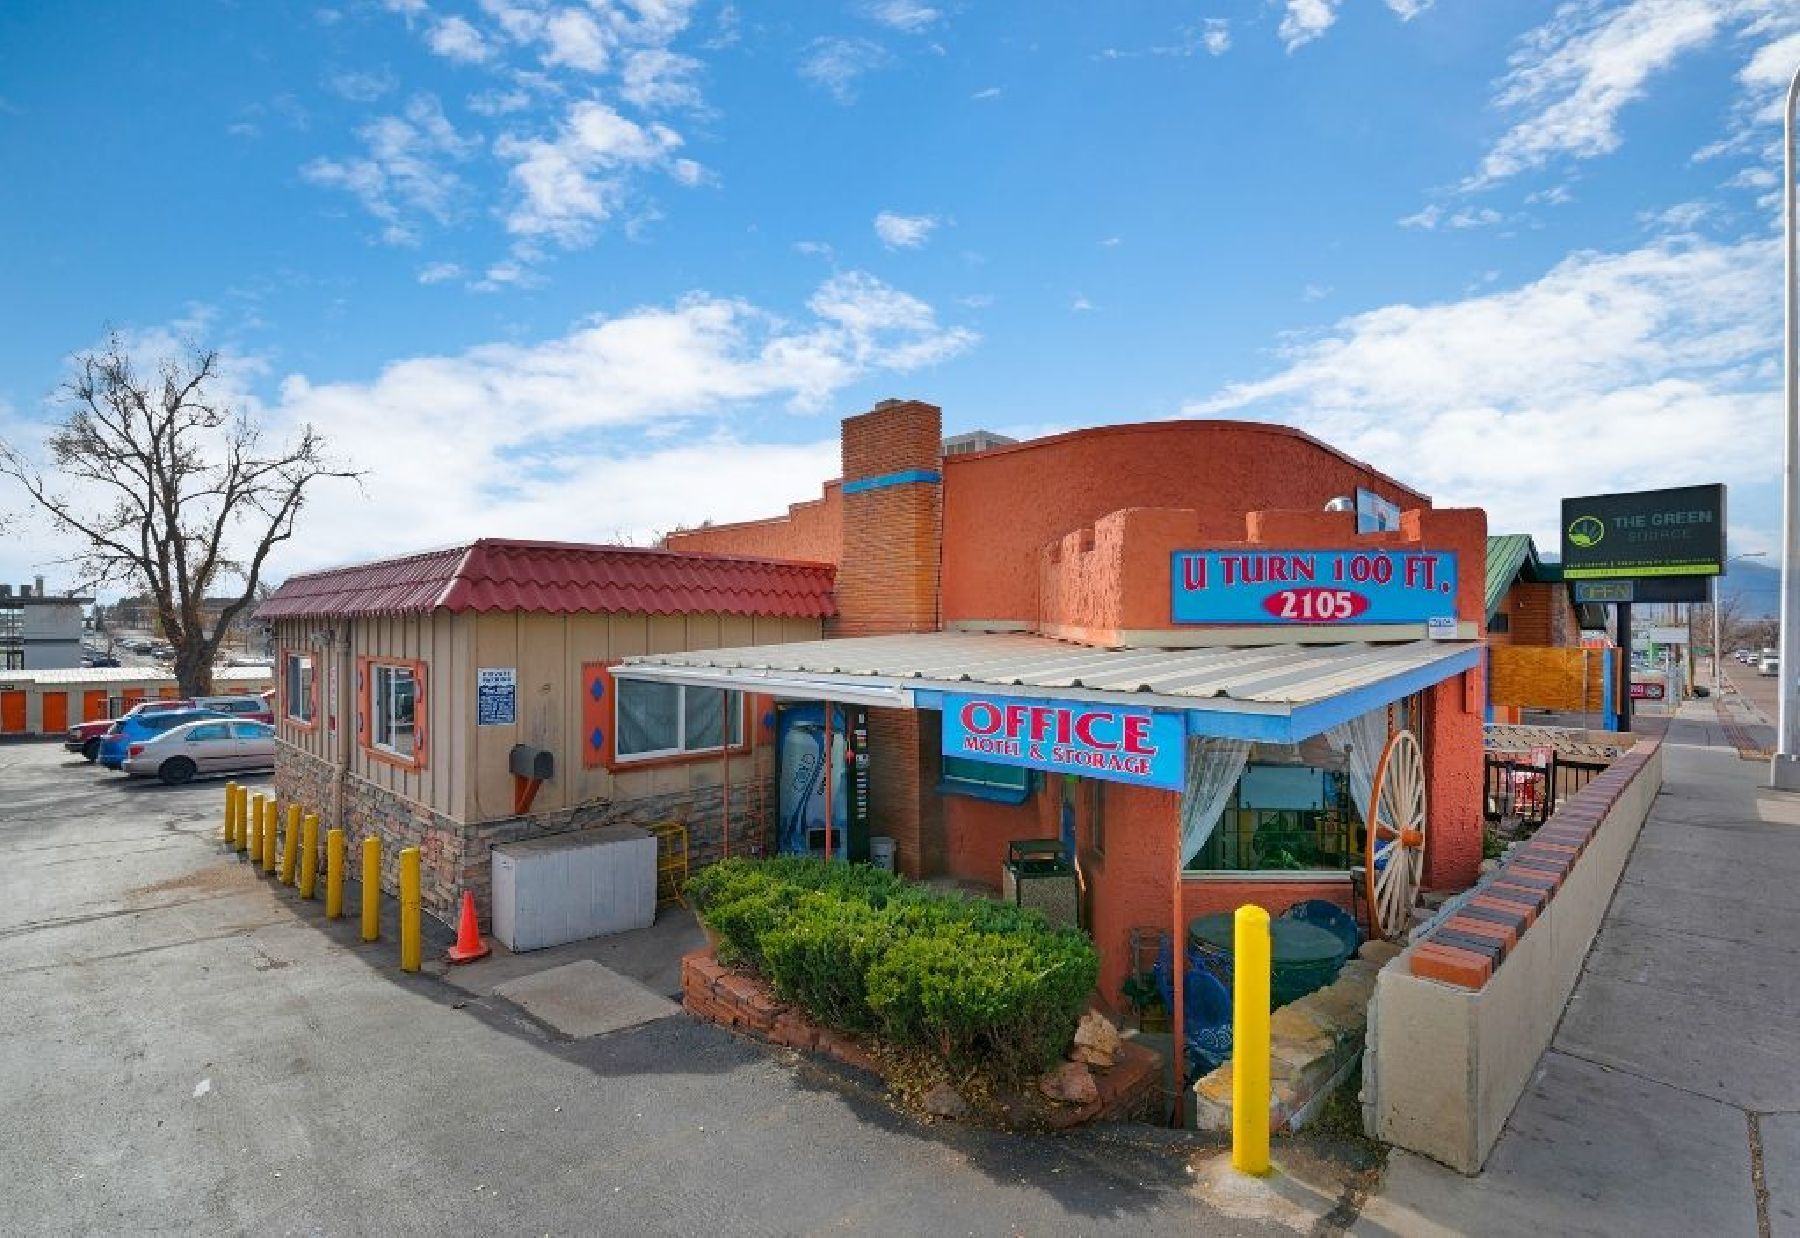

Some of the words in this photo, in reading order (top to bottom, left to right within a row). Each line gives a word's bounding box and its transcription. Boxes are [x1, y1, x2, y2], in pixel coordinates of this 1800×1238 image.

[1613, 515, 1646, 528] THE
[1652, 511, 1712, 526] GREEN
[1182, 555, 1208, 591] U
[1220, 555, 1315, 586] TURN
[1332, 554, 1393, 584] 100
[1404, 555, 1450, 594] FT.
[1280, 591, 1354, 618] 2105
[961, 701, 1157, 755] OFFICE
[963, 737, 1021, 755] MOTEL
[1029, 743, 1046, 761] &
[1052, 747, 1153, 776] STORAGE
